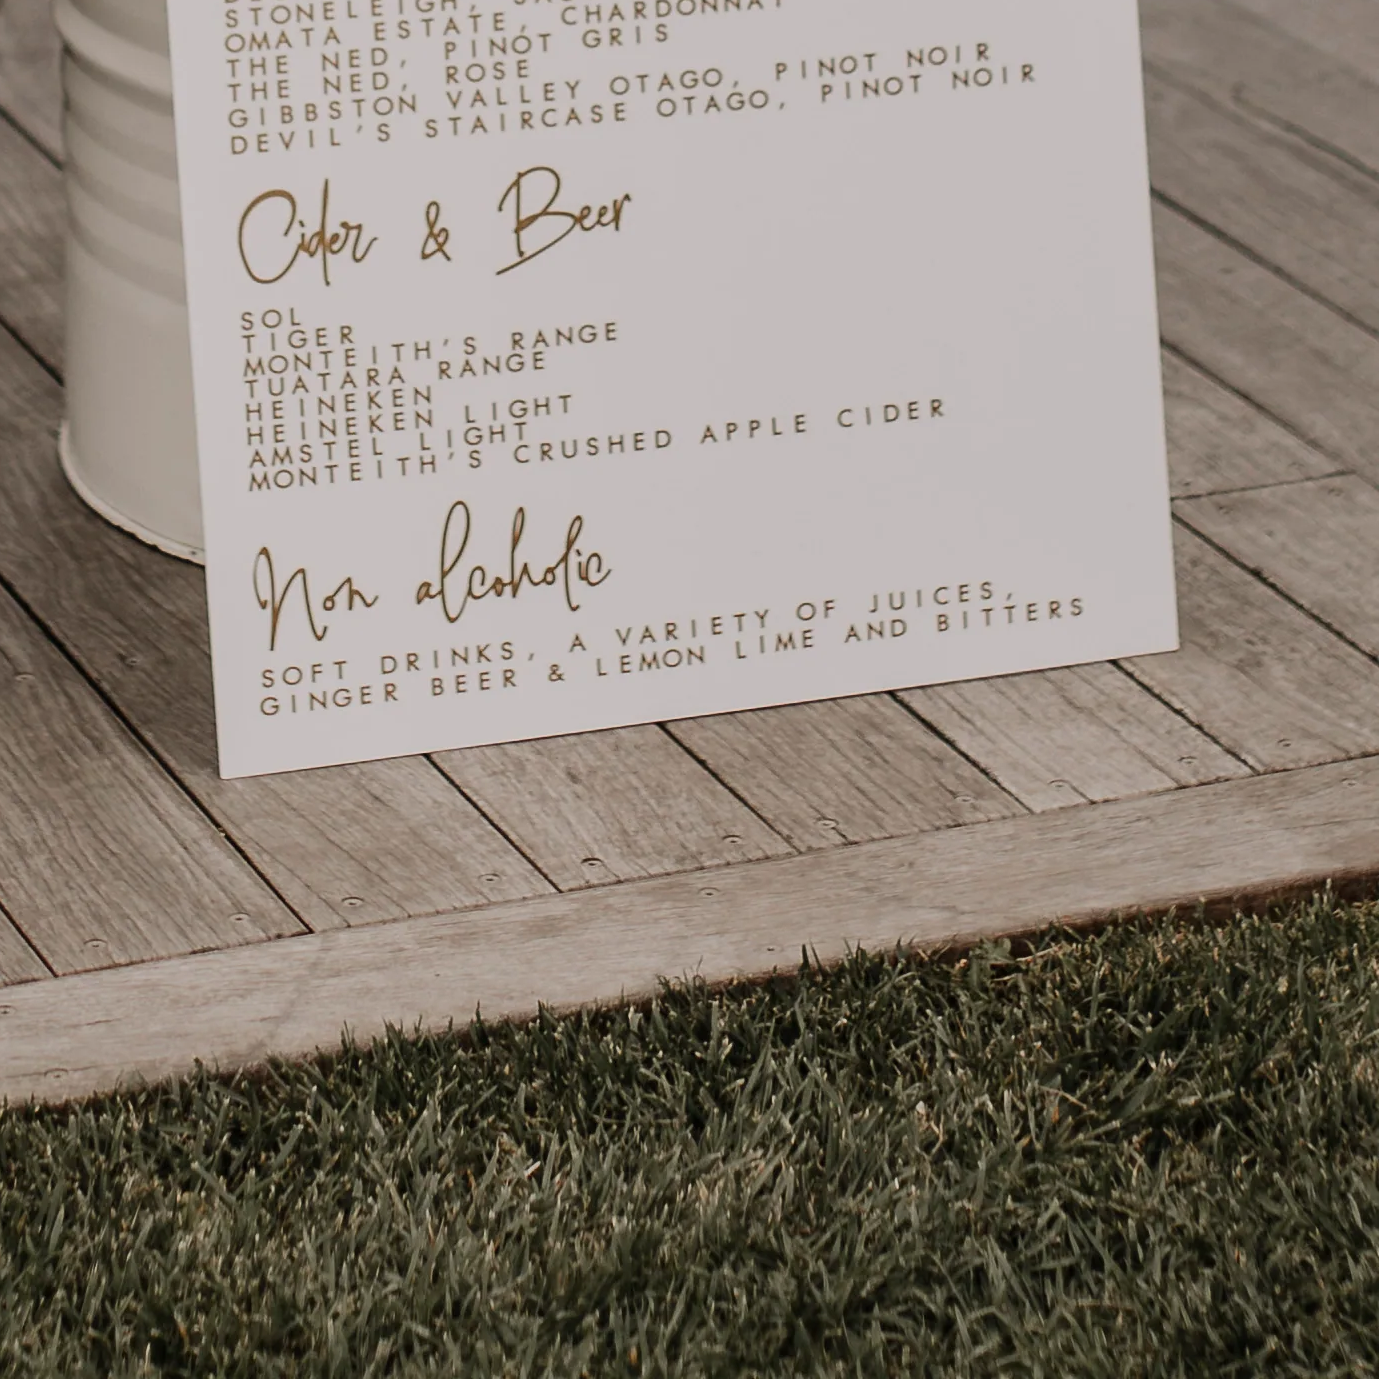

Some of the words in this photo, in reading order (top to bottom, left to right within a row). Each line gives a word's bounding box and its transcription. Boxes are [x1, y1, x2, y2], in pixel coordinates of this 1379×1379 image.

[223, 26, 342, 54] OMATA
[373, 11, 527, 42] ESTATE,
[225, 54, 289, 79] THE
[321, 46, 407, 72] NED,
[443, 32, 552, 61] PINOT
[581, 22, 669, 49] GRIS
[226, 78, 290, 103] THE
[322, 71, 408, 96] NED,
[445, 58, 530, 86] ROSE
[227, 93, 417, 129] GIBBSTON
[445, 79, 581, 111] VALLEY
[608, 67, 739, 96] OTAGO,
[774, 52, 877, 82] PINOT
[906, 42, 990, 68] NOIR
[230, 122, 391, 156] DEVIL'S
[424, 101, 627, 139] STAIRCASE
[655, 89, 786, 118] OTAGO,
[820, 73, 923, 104] PINOT
[951, 63, 1035, 91] NOIR
[236, 177, 379, 288] Cider
[419, 200, 453, 263] &
[494, 165, 633, 276] Beer
[240, 306, 302, 332] SOL
[240, 324, 355, 354] TIGER
[242, 335, 477, 378] MONTEITH'S
[510, 321, 618, 352] RANGE
[243, 365, 406, 400] TUATARA
[437, 350, 546, 380] RANGE
[244, 384, 432, 423] HEINEKEN
[246, 408, 433, 447] HEINEKEN
[464, 394, 572, 424] LIGHT
[248, 436, 384, 470] AMSTEL
[419, 421, 528, 452] LIGHT
[248, 449, 483, 493] MONTEITH'S
[512, 429, 673, 464] CRUSHED
[699, 413, 808, 445] APPLE
[836, 398, 945, 428] CIDER
[252, 545, 380, 652] Non
[414, 499, 613, 625] alcoholic
[259, 682, 399, 717] GINGER
[430, 668, 518, 697] BEER
[547, 663, 566, 683] &
[595, 645, 706, 678] LEMON
[734, 628, 815, 660] LIME
[843, 618, 908, 644] AND
[936, 597, 1084, 633] BITTERS
[261, 660, 348, 689] SOFT
[380, 641, 535, 676] DRINKS,
[568, 633, 588, 654] A
[614, 608, 770, 647] VARIETY
[795, 598, 836, 622] OF
[868, 580, 1013, 614] JUICES,
